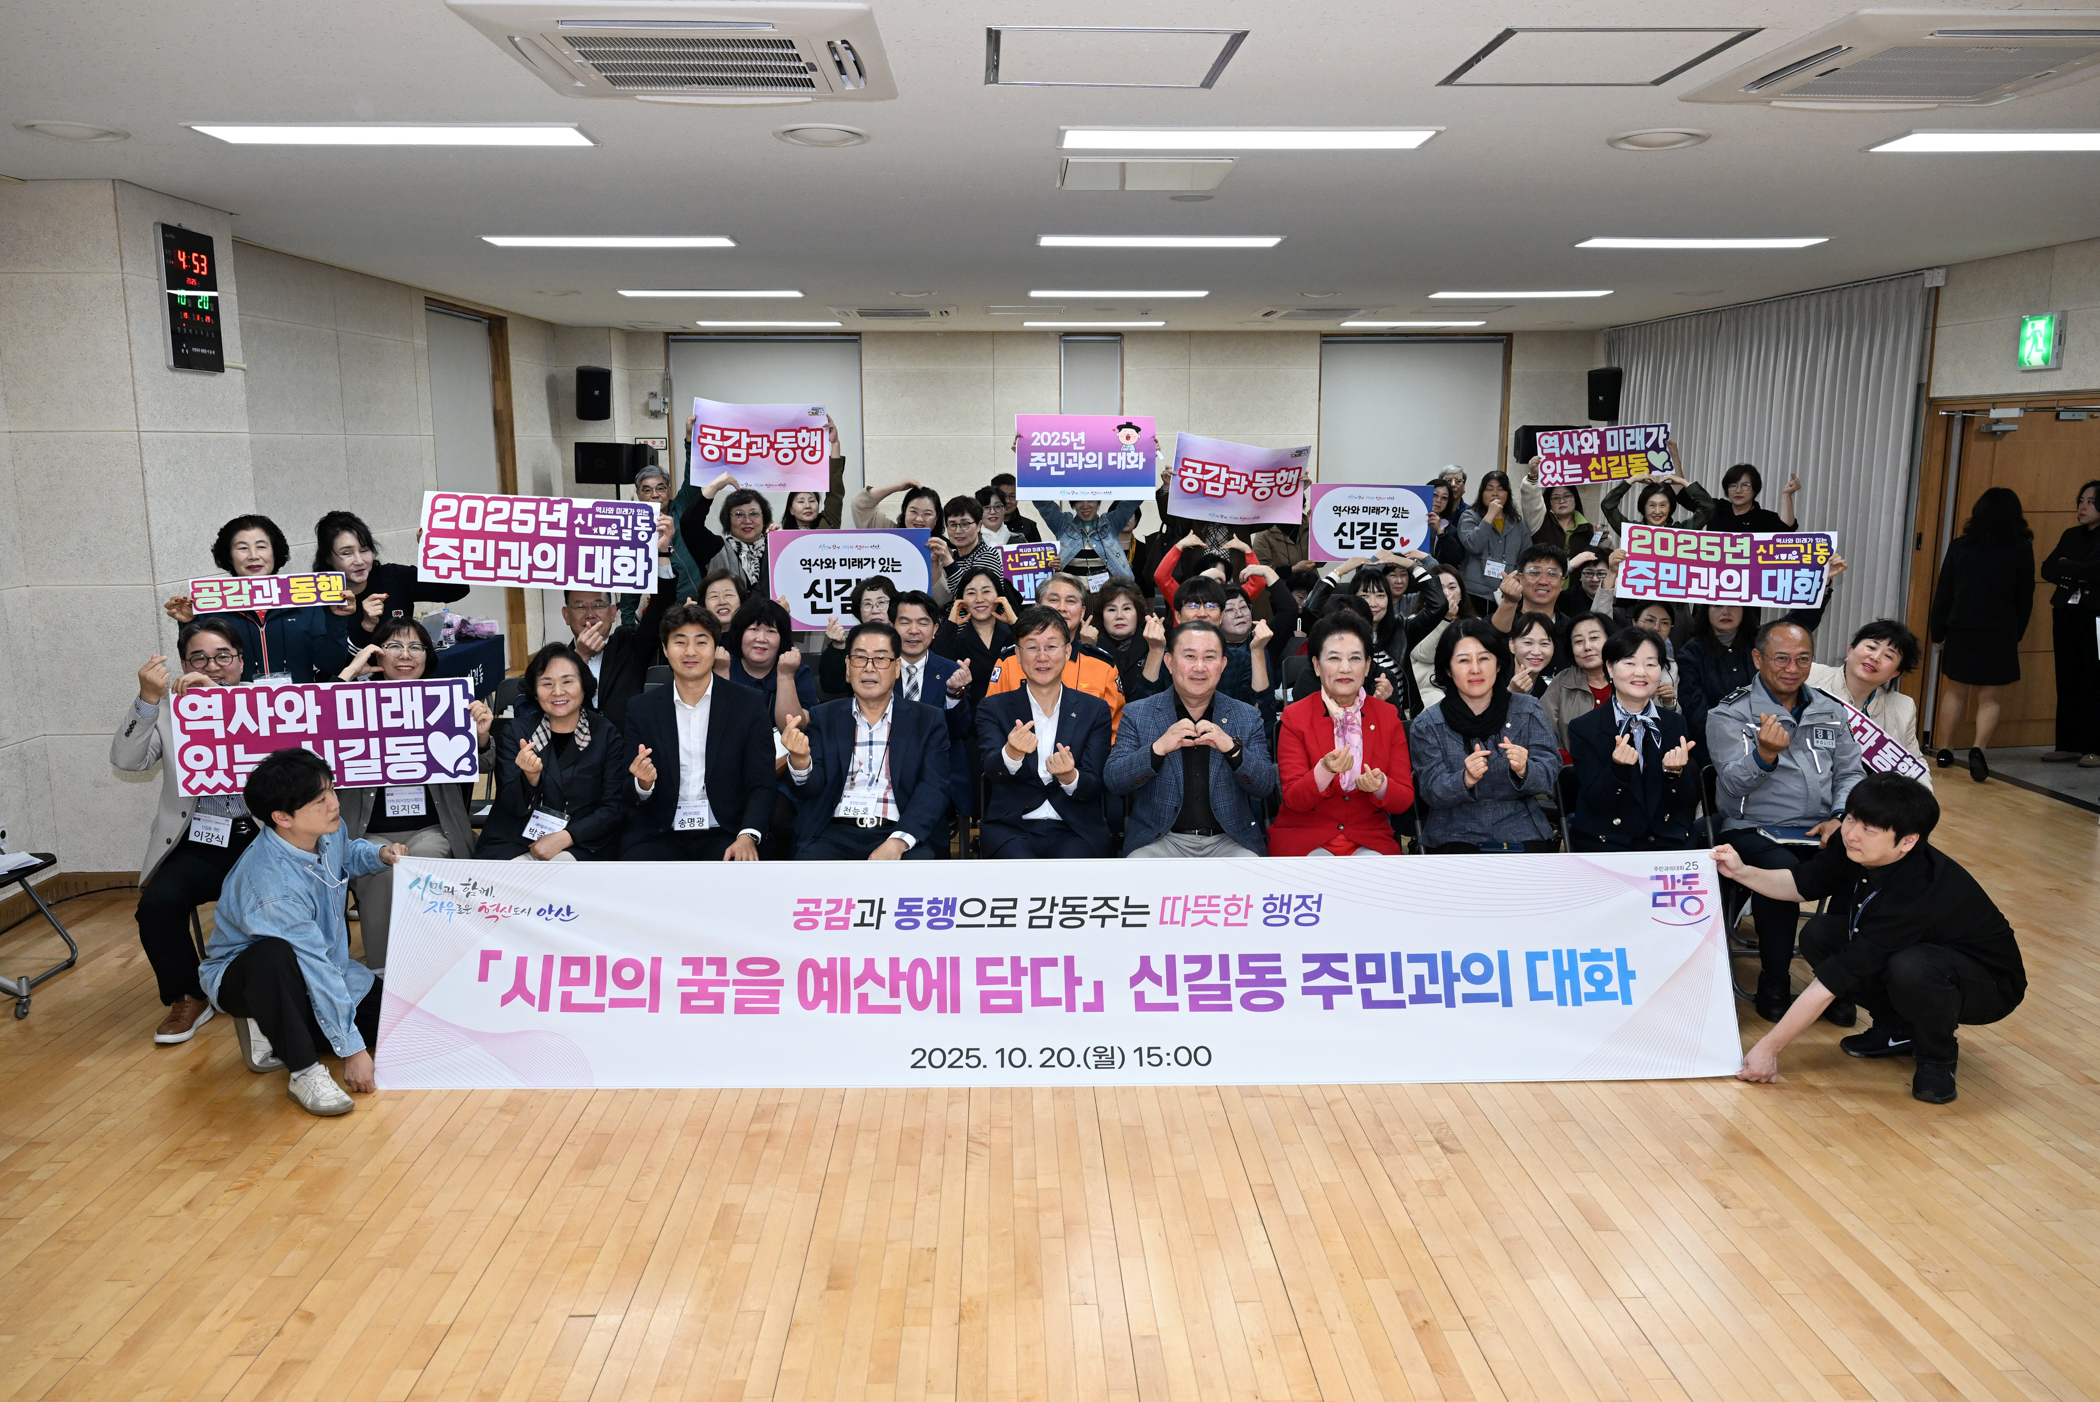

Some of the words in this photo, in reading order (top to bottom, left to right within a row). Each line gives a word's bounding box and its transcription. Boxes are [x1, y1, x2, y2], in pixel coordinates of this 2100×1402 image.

[178, 249, 207, 276] 4:53
[700, 427, 770, 463] 공감과
[774, 429, 822, 463] 동행
[1031, 432, 1085, 450] 2025년
[1540, 431, 1600, 458] 역사와
[1606, 427, 1667, 452] 미래가
[1029, 452, 1103, 476] 주민과의
[1107, 451, 1146, 470] 대화
[1542, 460, 1583, 486] 있는
[1588, 453, 1650, 480] 신길동
[1180, 460, 1248, 496] 공감과
[1252, 469, 1300, 500] 동행
[431, 497, 569, 537] 2025년
[595, 506, 614, 514] 역사와
[616, 507, 635, 515] 미래가
[636, 508, 649, 516] 있는
[1332, 505, 1360, 517] 역사와
[1362, 506, 1390, 515] 미래가
[1391, 507, 1410, 519] 있는
[573, 513, 653, 541] 신길동
[1334, 521, 1399, 550] 신길동
[1630, 529, 1750, 565] 2025년
[1756, 543, 1831, 564] 신길동
[426, 537, 567, 582] 주민과의
[577, 545, 649, 587] 대화
[800, 558, 837, 574] 역사와
[839, 557, 876, 570] 미래가
[878, 557, 902, 573] 있는
[193, 578, 282, 609] 공감과
[289, 574, 344, 604] 동행
[1625, 560, 1750, 600] 주민과의
[1761, 568, 1822, 602] 대화
[178, 690, 321, 739] 역사와
[334, 684, 470, 732] 미래가
[1816, 729, 1833, 740] 경찰
[390, 804, 420, 815] 임지연
[678, 816, 705, 828] 송명광
[193, 830, 224, 846] 이강식
[1684, 861, 1699, 871] 25
[408, 873, 457, 901] 시민과
[1649, 873, 1708, 917] 감동
[423, 900, 473, 923] 자유로운
[477, 901, 531, 923] 혁신도시
[536, 904, 580, 922] 안산
[792, 897, 887, 931] 공감과
[894, 896, 1018, 931] 동행으로
[1027, 895, 1151, 929] 감동주는
[1158, 894, 1254, 928] 따뜻한
[1262, 893, 1323, 927] 행정
[478, 949, 662, 1013] 「시민의
[677, 956, 784, 1014] 꿈을
[797, 956, 961, 1014] 예산에
[975, 954, 1104, 1014] 담다」
[1129, 953, 1287, 1013] 신길동
[1300, 950, 1513, 1011] 주민과의
[1525, 947, 1637, 1007] 대화
[910, 1047, 987, 1069] 2025.
[995, 1047, 1032, 1069] 10.
[1133, 1045, 1213, 1067] 15:00
